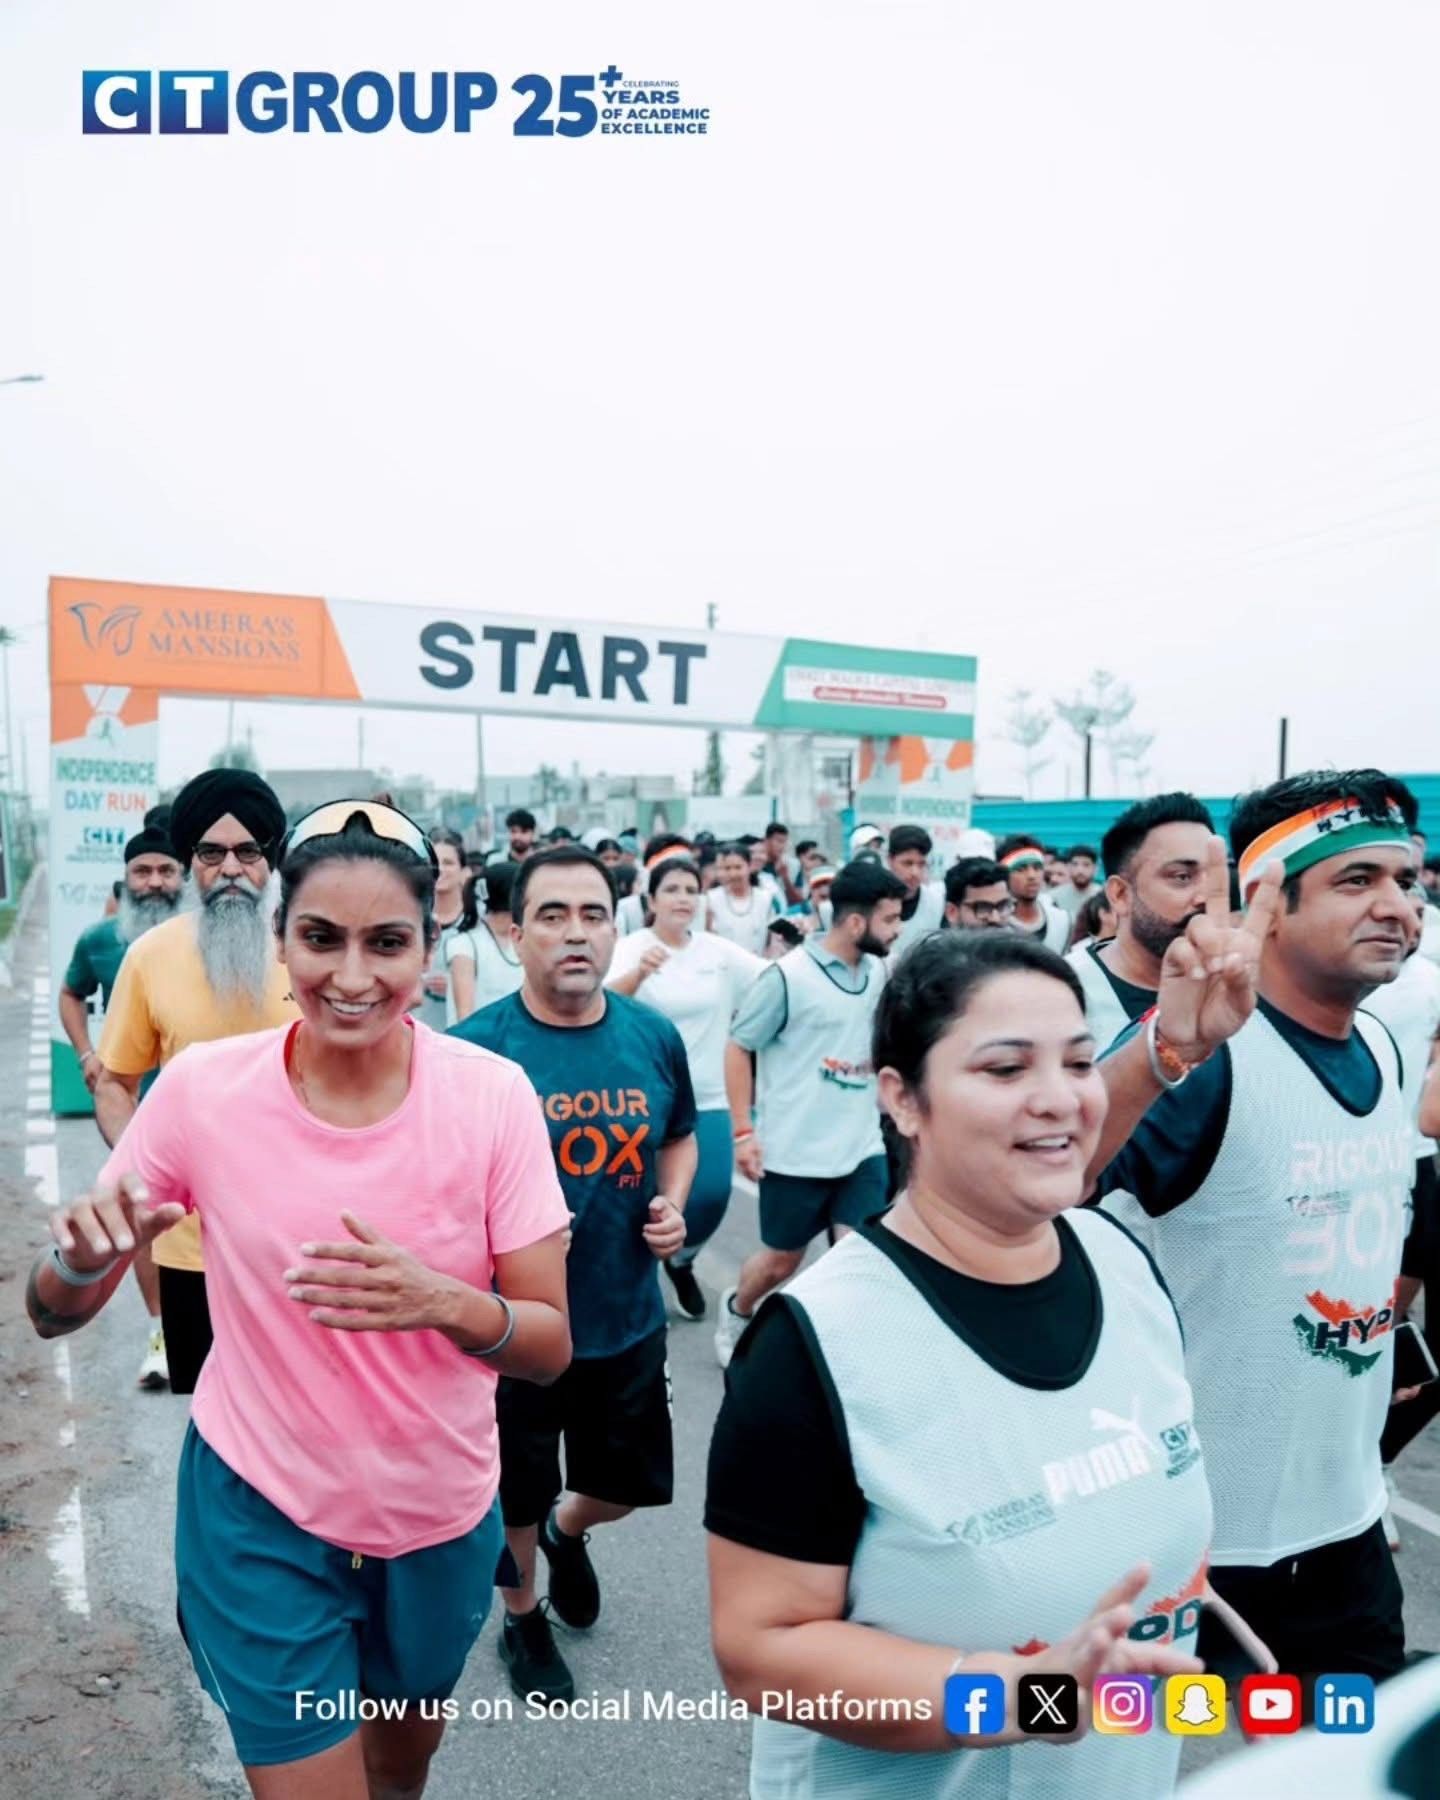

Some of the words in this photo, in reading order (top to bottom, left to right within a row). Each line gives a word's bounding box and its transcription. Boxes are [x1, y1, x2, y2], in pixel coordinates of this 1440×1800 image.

[158, 607, 295, 637] AMEERA'S
[148, 631, 301, 660] MANSIONS
[419, 621, 707, 705] START
[64, 788, 103, 811] DAY
[106, 791, 147, 811] RUN
[560, 1123, 650, 1176] OX
[1042, 1433, 1151, 1505] PUMA
